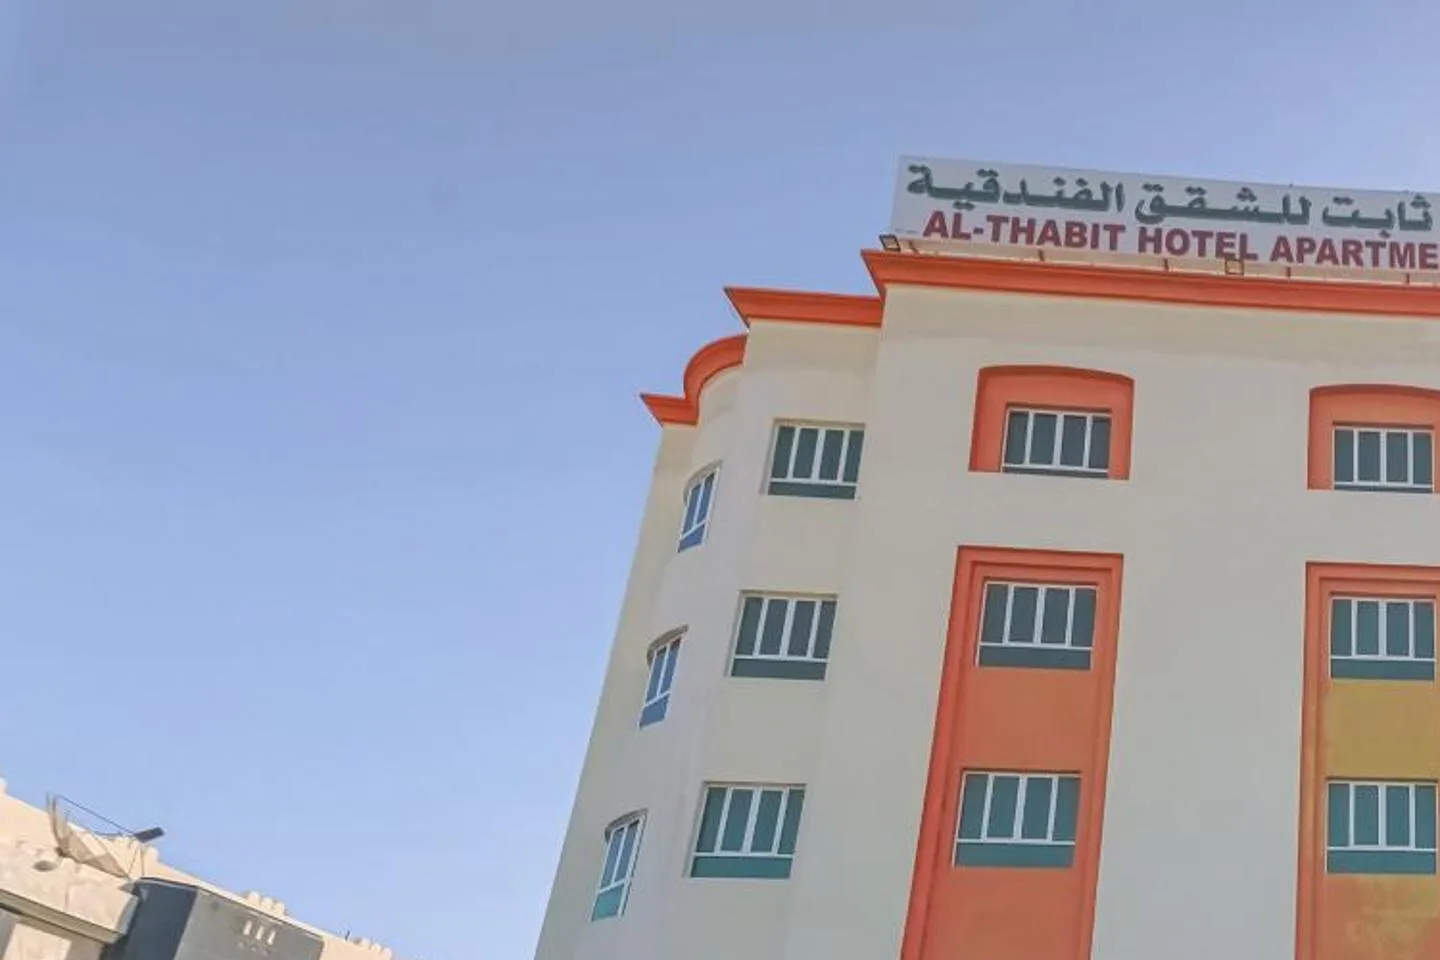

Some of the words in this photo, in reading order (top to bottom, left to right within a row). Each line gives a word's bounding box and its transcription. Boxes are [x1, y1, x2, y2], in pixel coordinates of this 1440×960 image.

[906, 164, 1126, 213] الفندقية
[1134, 183, 1312, 225] للشقق
[922, 209, 1126, 251] AL-THABIT
[1138, 226, 1259, 262] HOTEL
[1321, 192, 1434, 239] ثابت
